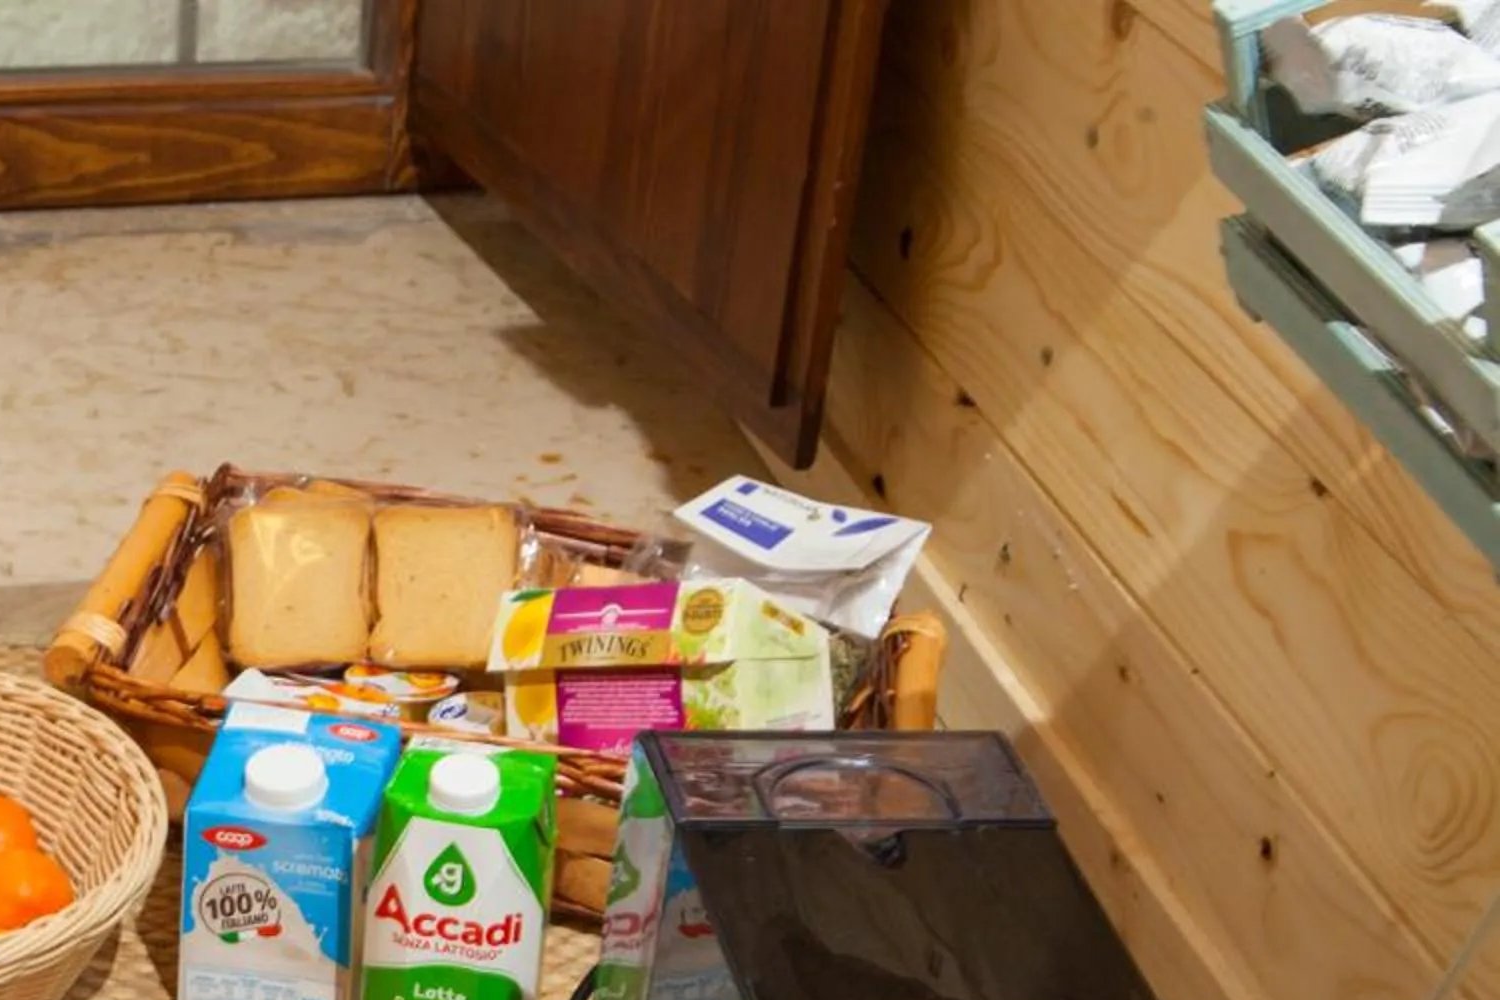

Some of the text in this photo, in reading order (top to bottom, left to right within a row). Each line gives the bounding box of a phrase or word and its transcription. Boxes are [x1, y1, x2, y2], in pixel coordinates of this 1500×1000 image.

[559, 635, 654, 663] TWININGS
[215, 831, 253, 846] coop
[206, 889, 277, 920] 100%
[374, 884, 523, 947] Accadi
